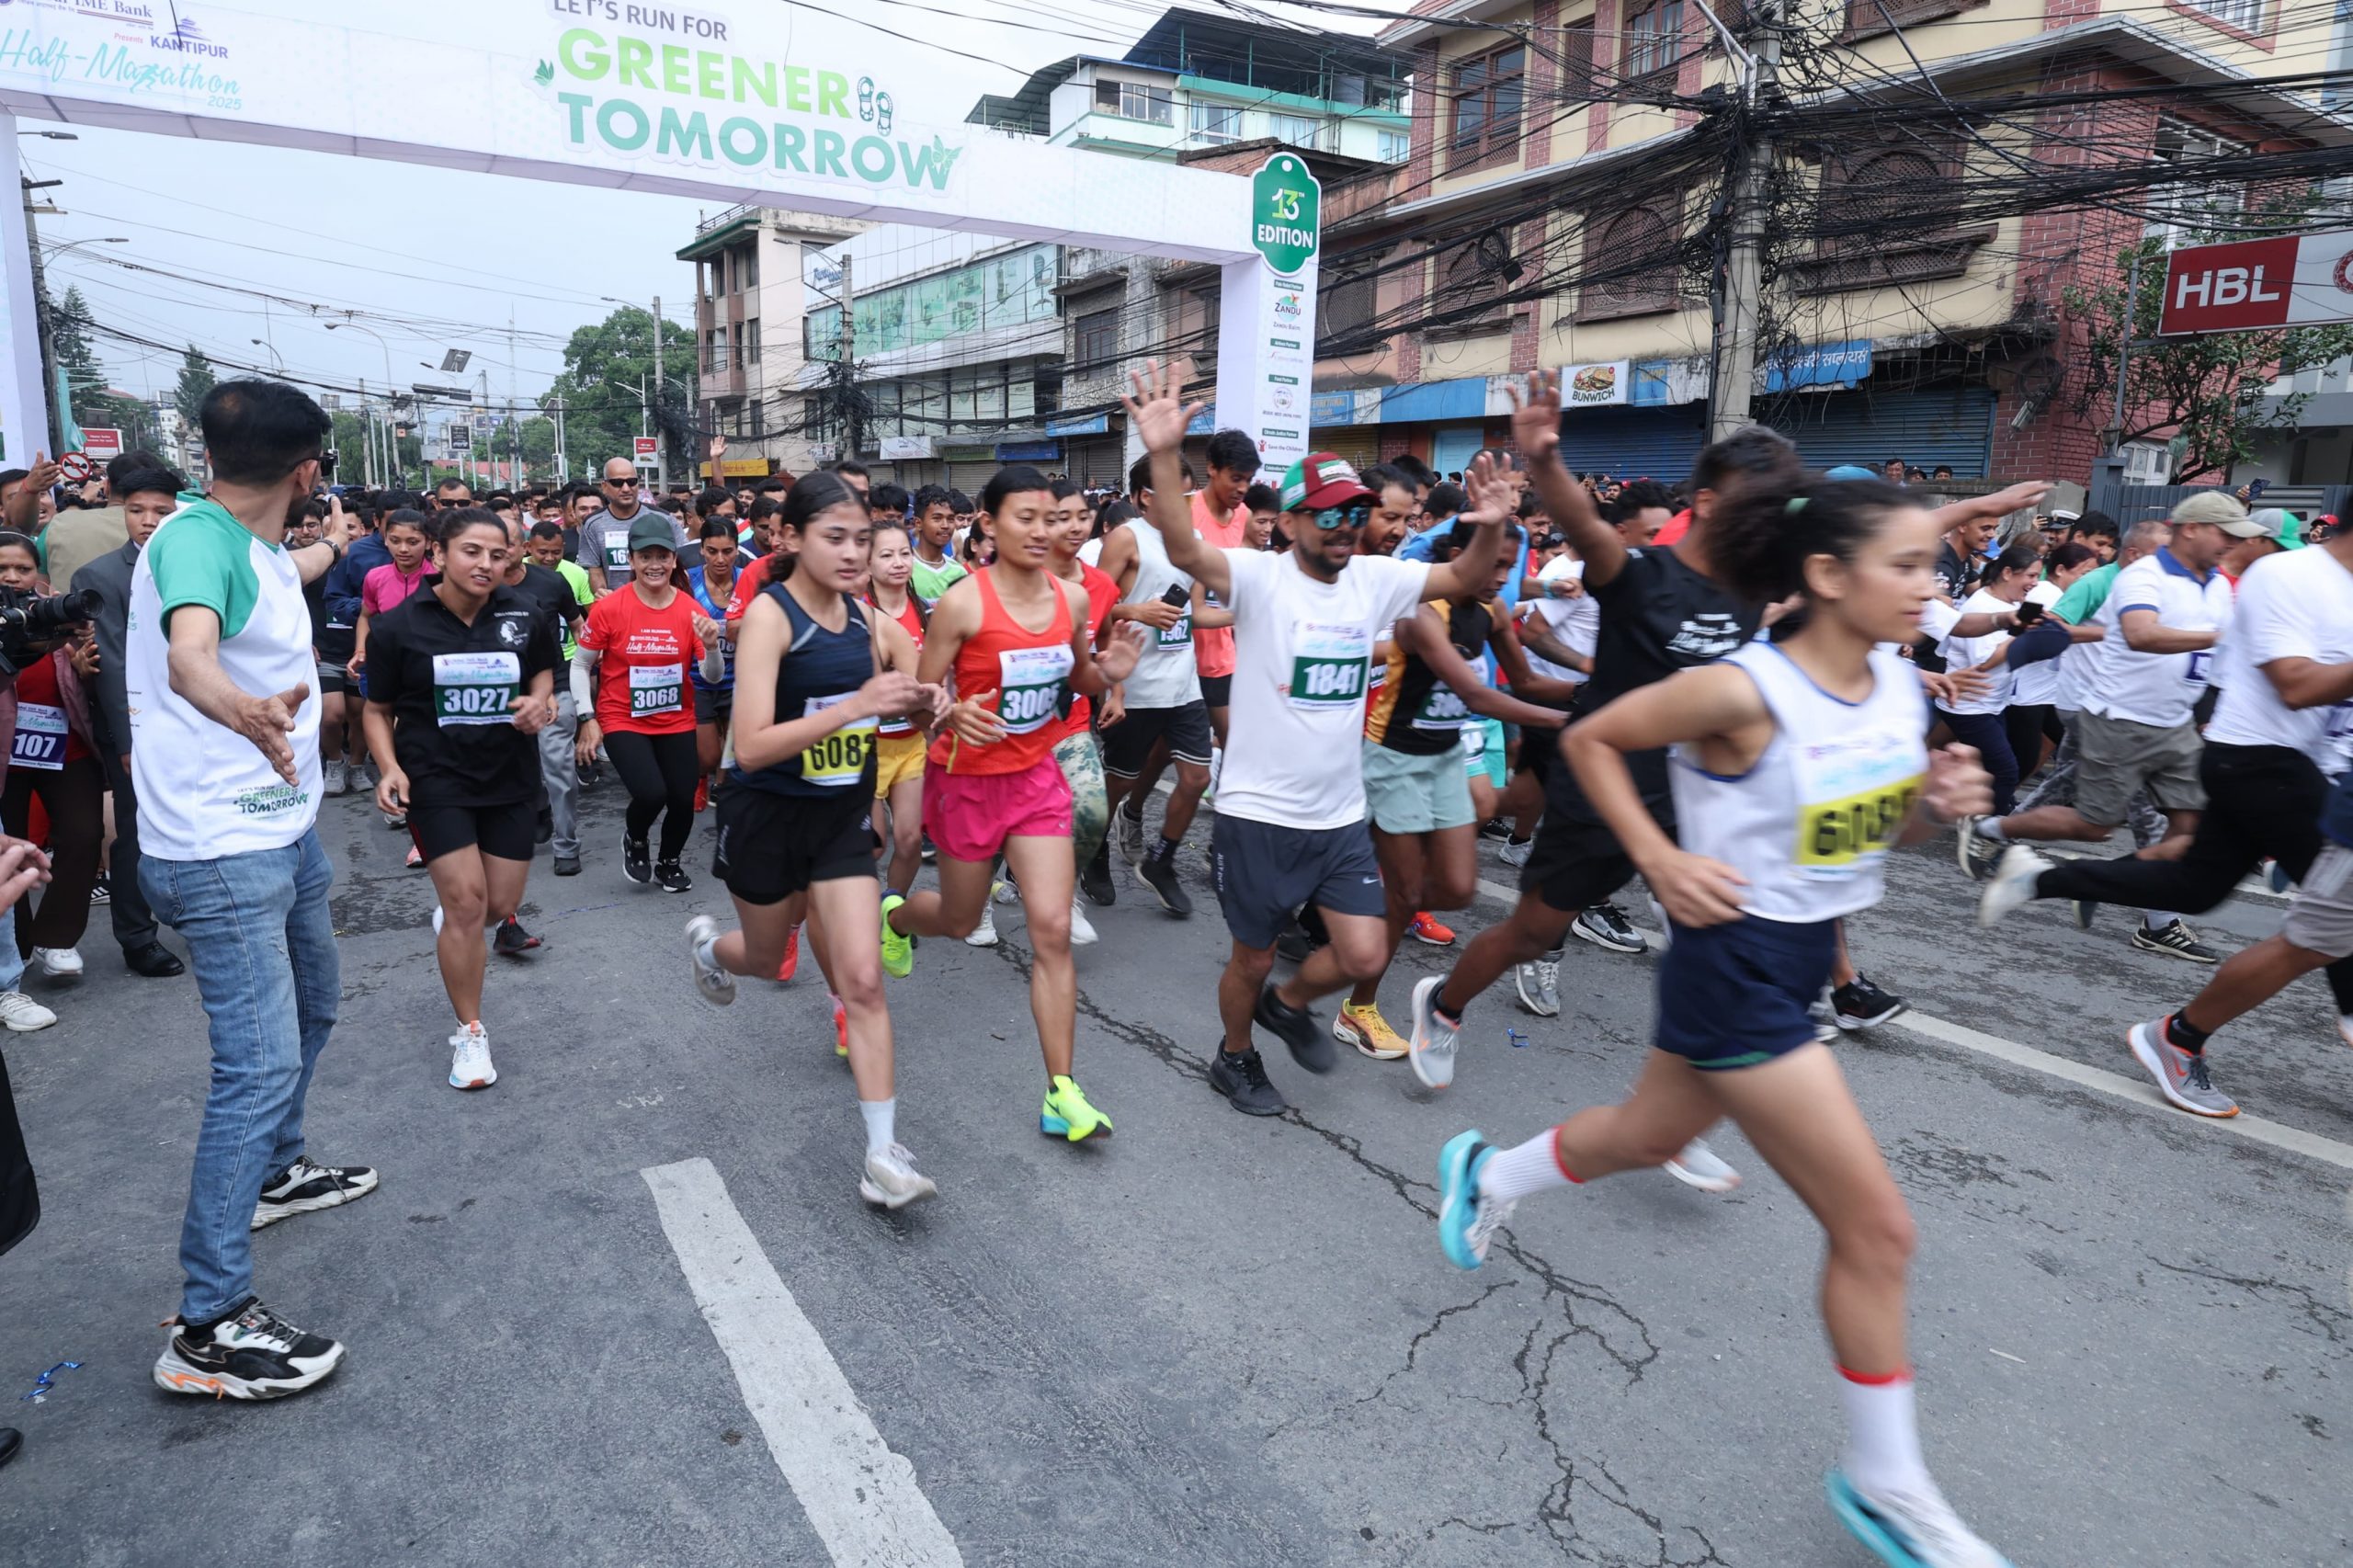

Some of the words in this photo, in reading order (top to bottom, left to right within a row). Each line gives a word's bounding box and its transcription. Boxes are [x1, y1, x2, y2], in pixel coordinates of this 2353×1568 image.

[115, 2, 153, 17] Bank
[627, 4, 675, 32] RUN
[683, 15, 727, 41] FOR
[150, 35, 229, 59] KANTIPUR
[557, 28, 853, 119] GREENER
[207, 96, 243, 111] 2025
[558, 92, 956, 190] TOMORROW
[1257, 223, 1313, 249] EDITION
[2175, 264, 2280, 310] HBL
[1274, 302, 1302, 316] ZANDU
[1572, 387, 1615, 403] BUNWICH
[1303, 663, 1362, 695] 1841
[444, 687, 510, 713] 3027
[634, 687, 678, 709] 3068
[15, 733, 56, 758] 107
[239, 792, 309, 813] TOMORROW
[240, 787, 290, 802] GREENER
